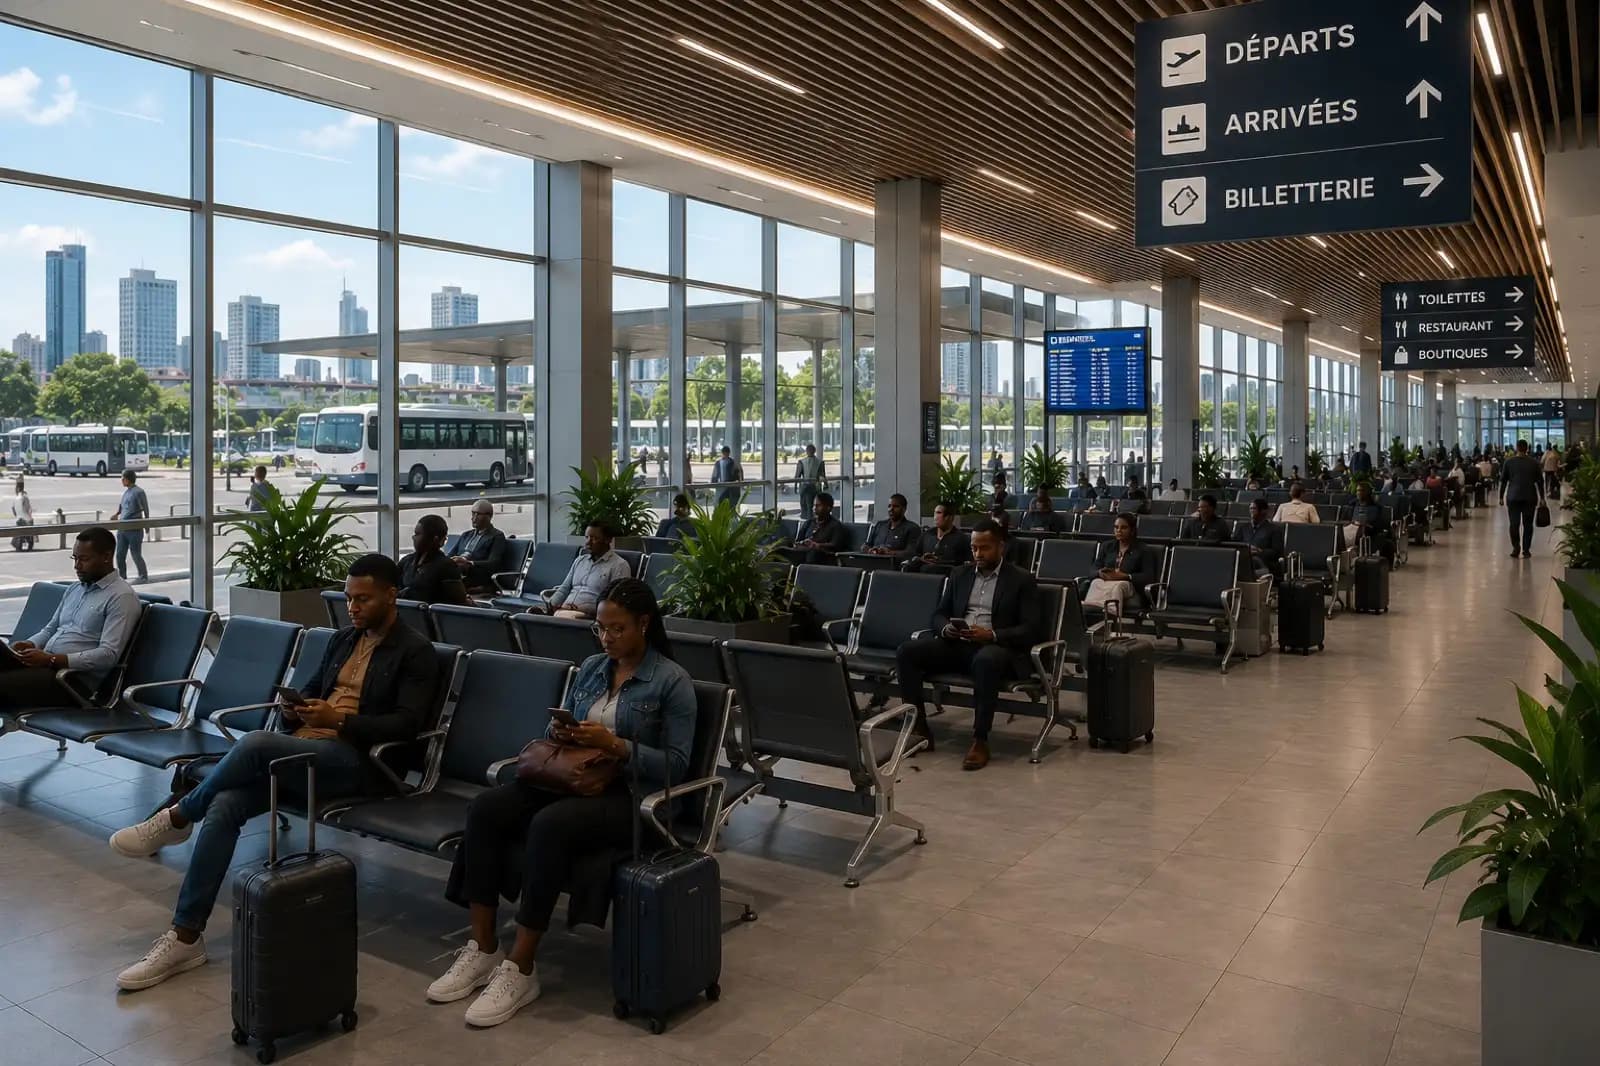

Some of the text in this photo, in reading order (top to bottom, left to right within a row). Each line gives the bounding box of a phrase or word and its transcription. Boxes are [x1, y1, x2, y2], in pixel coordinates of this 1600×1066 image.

[1225, 24, 1355, 65] DÉPARTS
[1224, 98, 1358, 135] ARRIVÉES
[1225, 177, 1375, 209] BILLETTERIE
[1419, 291, 1486, 305] TOILETTES
[1418, 320, 1494, 333] RESTAURANT
[1418, 348, 1488, 360] BOUTIQUES
